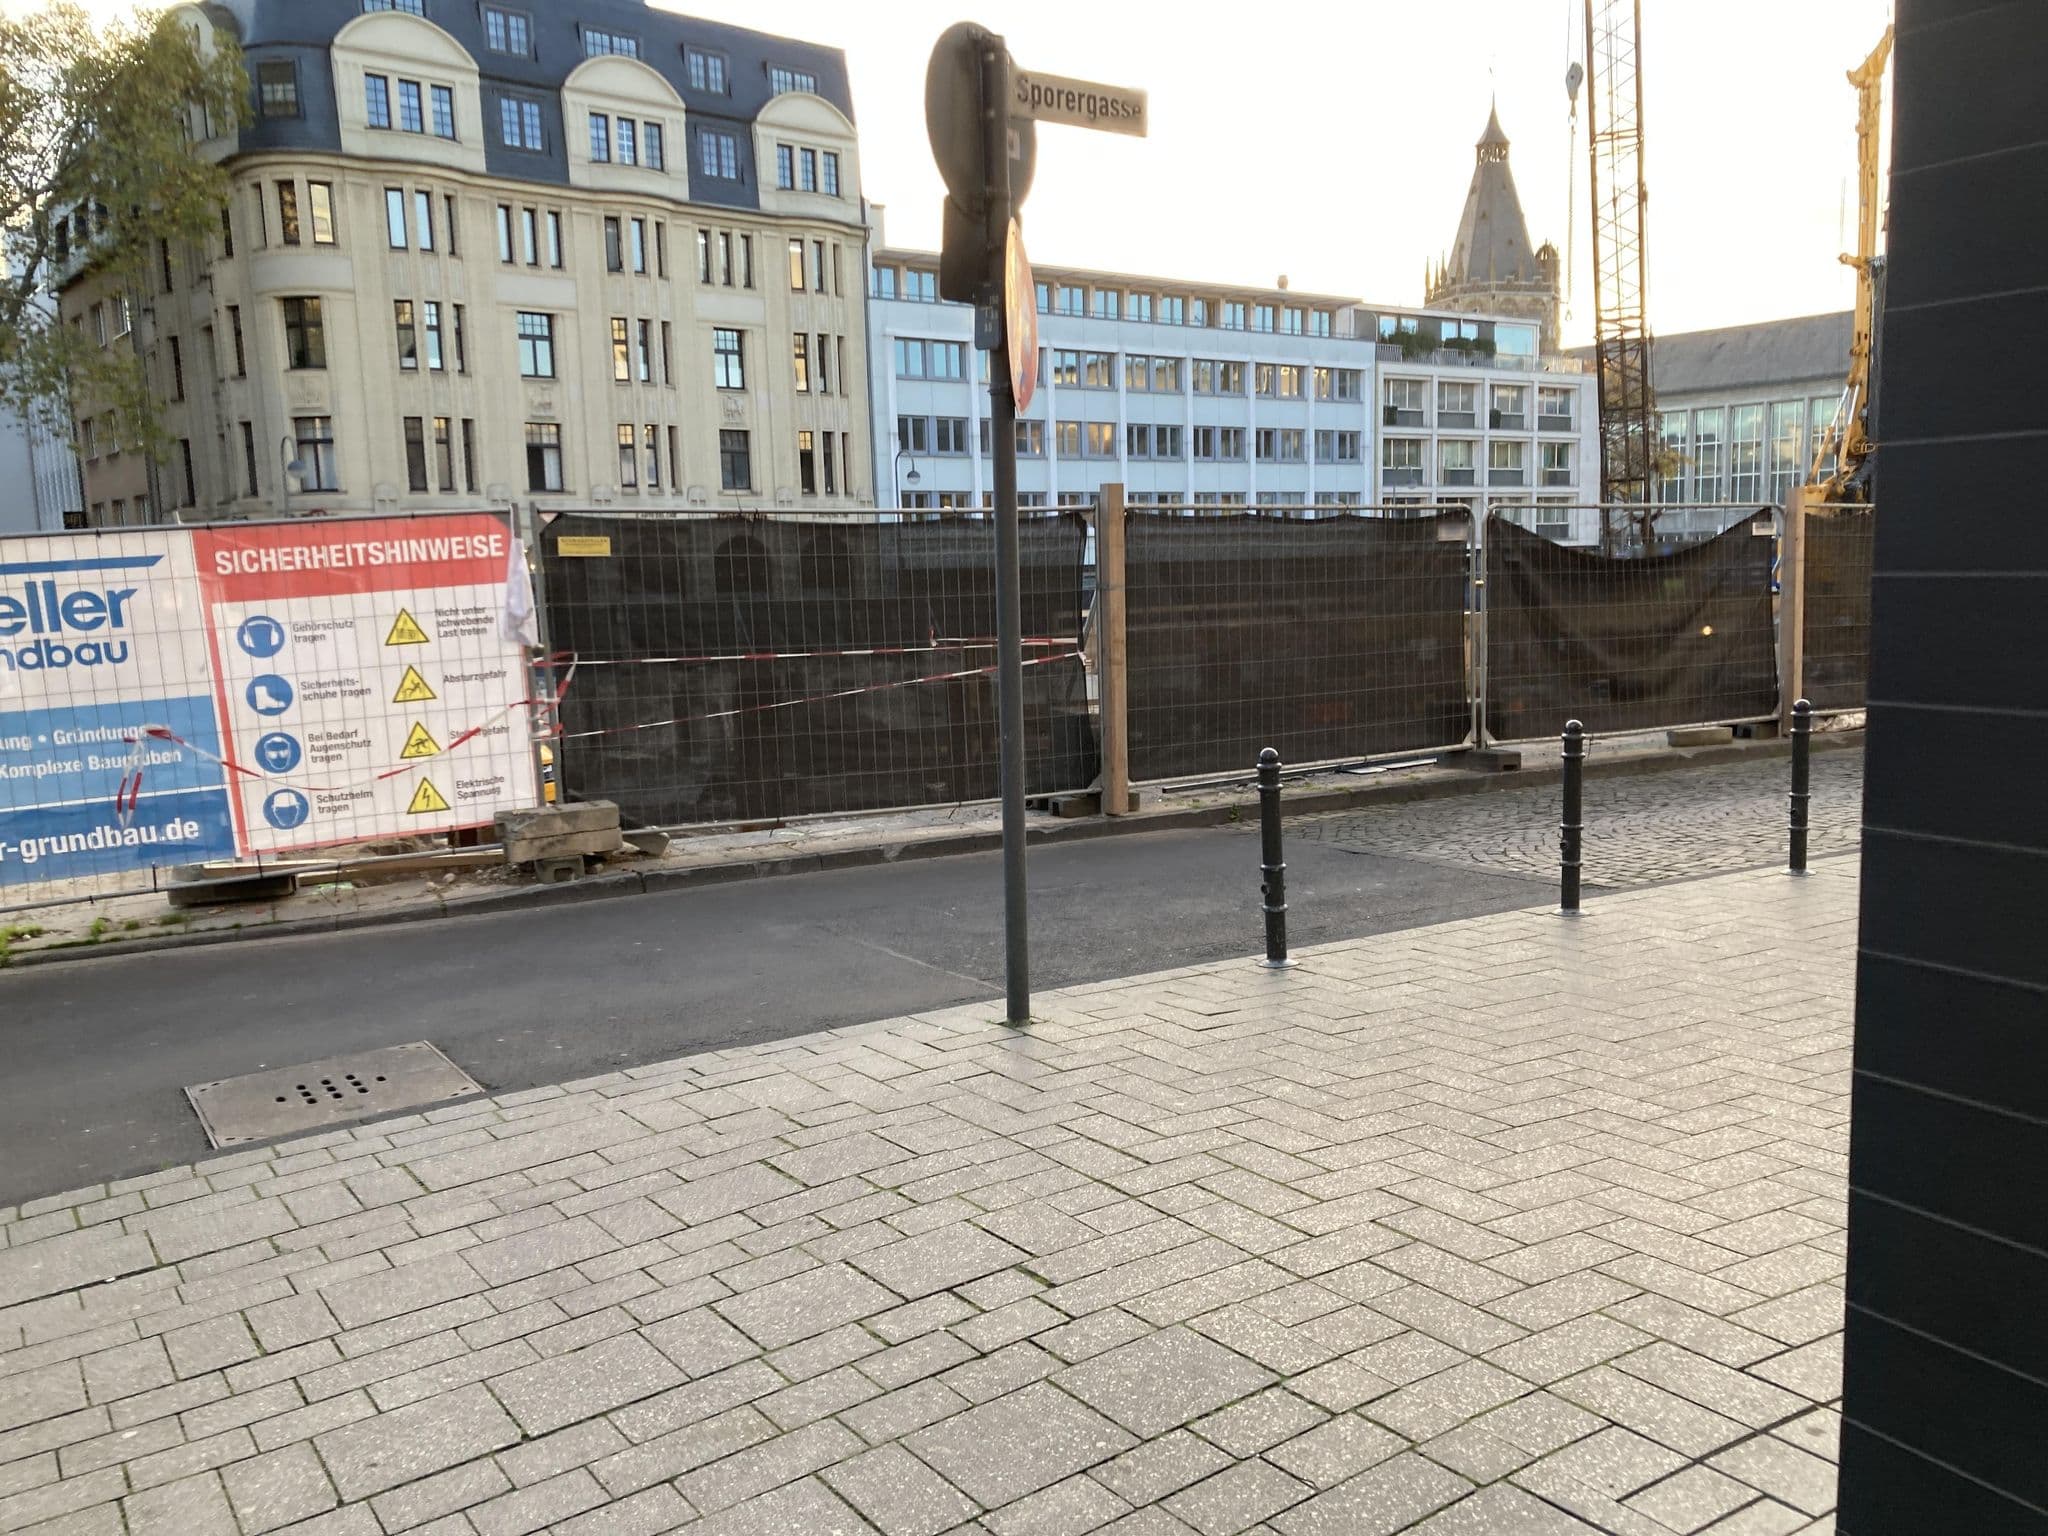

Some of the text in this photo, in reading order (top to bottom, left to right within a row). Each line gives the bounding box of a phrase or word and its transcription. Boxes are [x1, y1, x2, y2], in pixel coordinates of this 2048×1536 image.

[1017, 74, 1141, 119] Sporergasse
[215, 534, 504, 575] SICHERHEITSHINWEISE
[294, 633, 326, 643] tragen
[438, 629, 458, 638] Last
[301, 678, 359, 690] Sicherheits-
[302, 688, 372, 701] schuhe tragen
[308, 729, 358, 742] Bei Bedarf
[310, 740, 371, 753] Augenschutz
[311, 753, 342, 763] tragen
[316, 790, 373, 803] Schutzhelm
[318, 804, 349, 814] tragen
